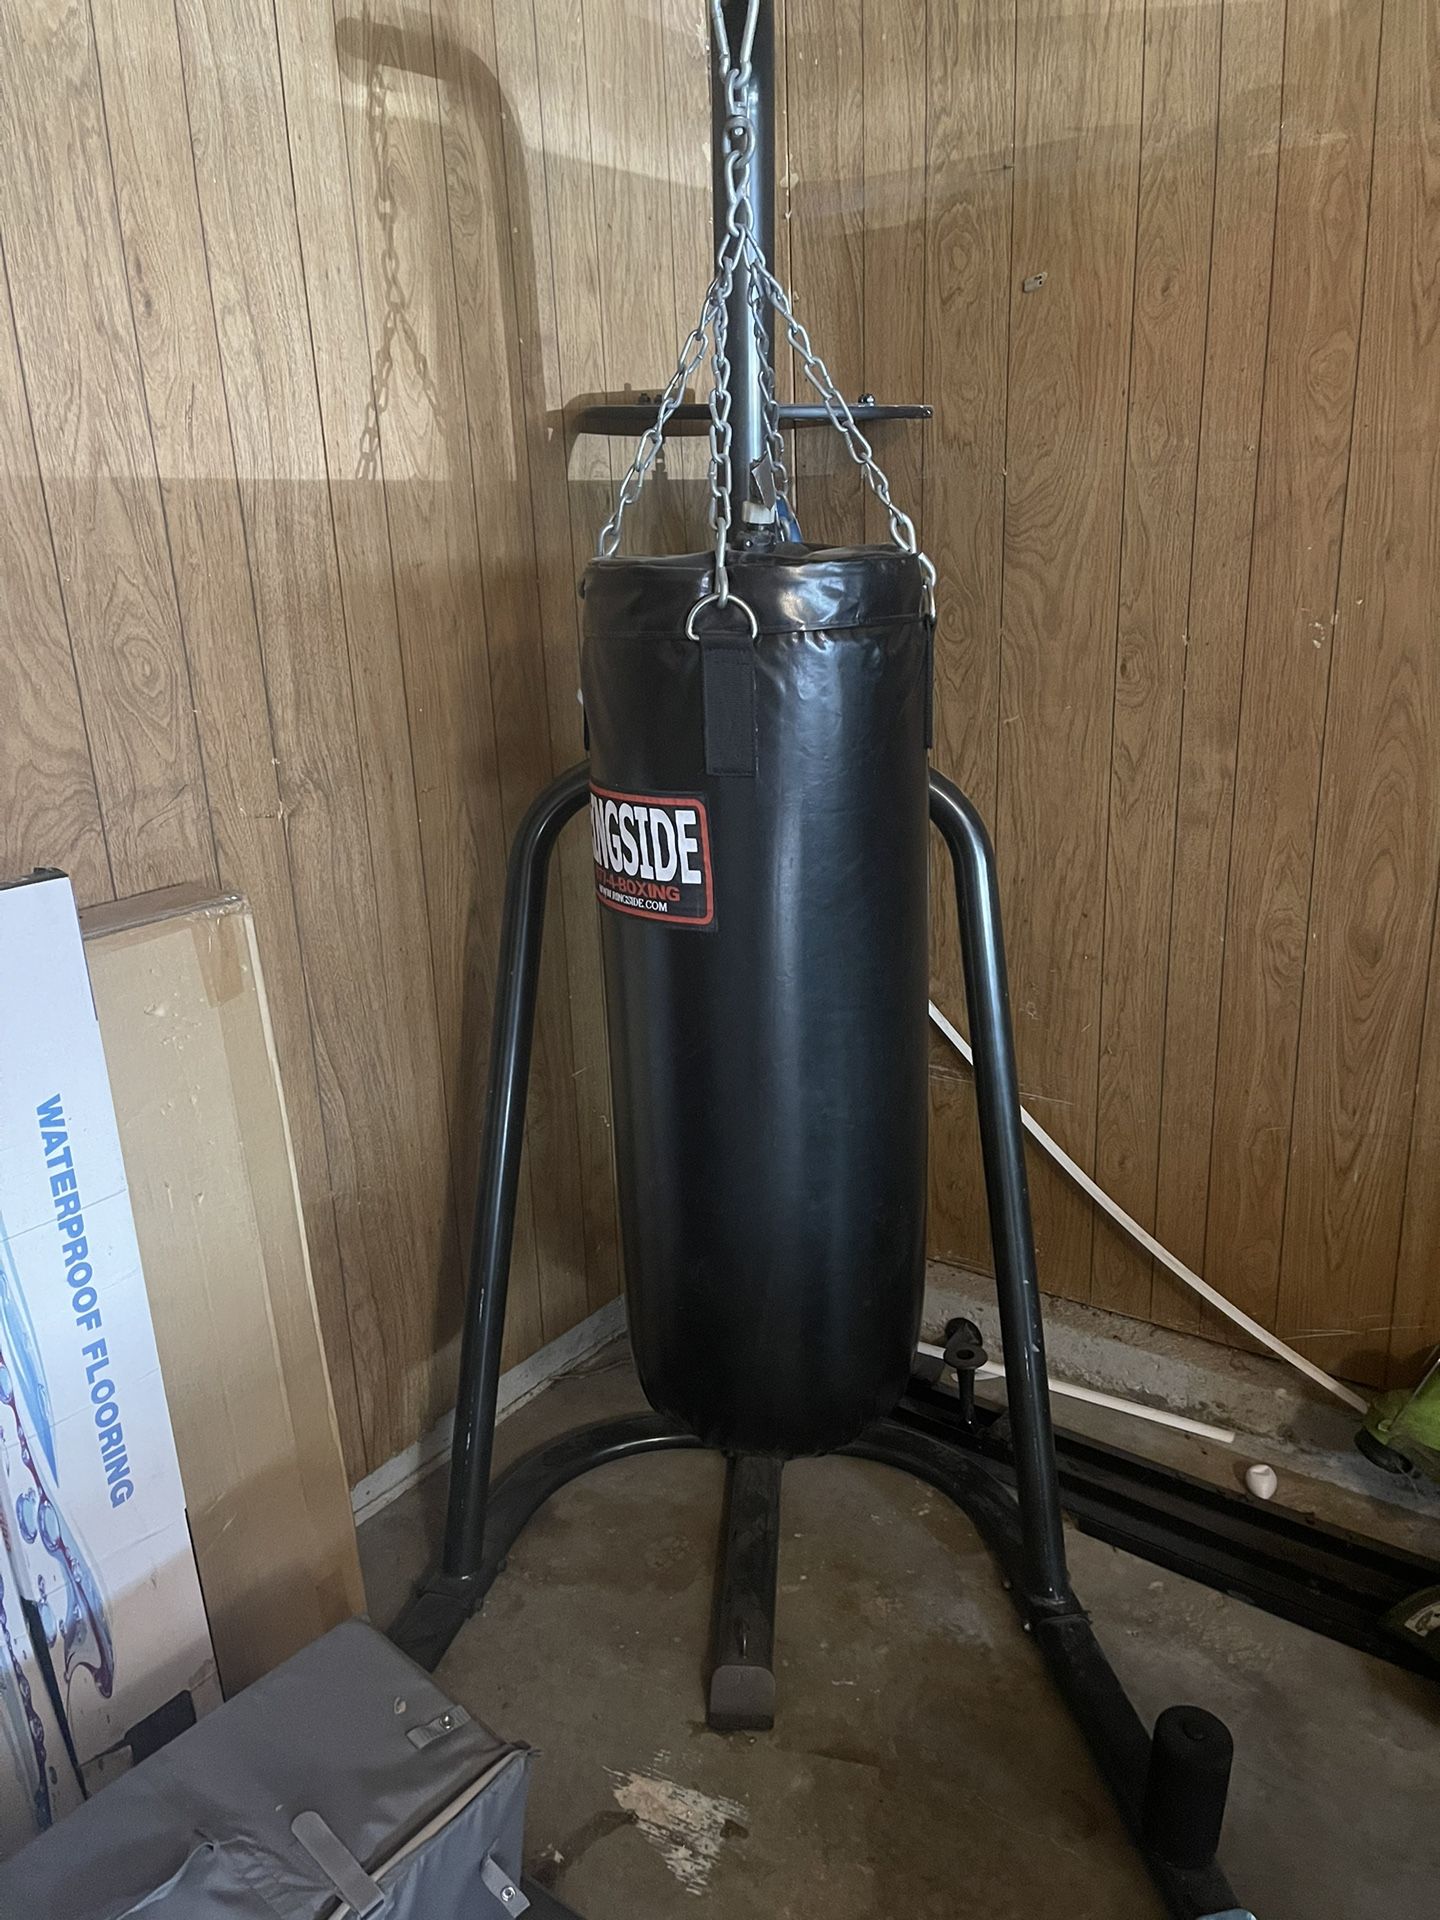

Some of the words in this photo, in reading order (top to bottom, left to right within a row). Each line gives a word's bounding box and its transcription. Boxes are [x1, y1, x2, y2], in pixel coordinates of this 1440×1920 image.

[590, 792, 702, 884] INGSIDE
[36, 1093, 103, 1331] WATERPROOF
[82, 1338, 135, 1508] FLOORING
